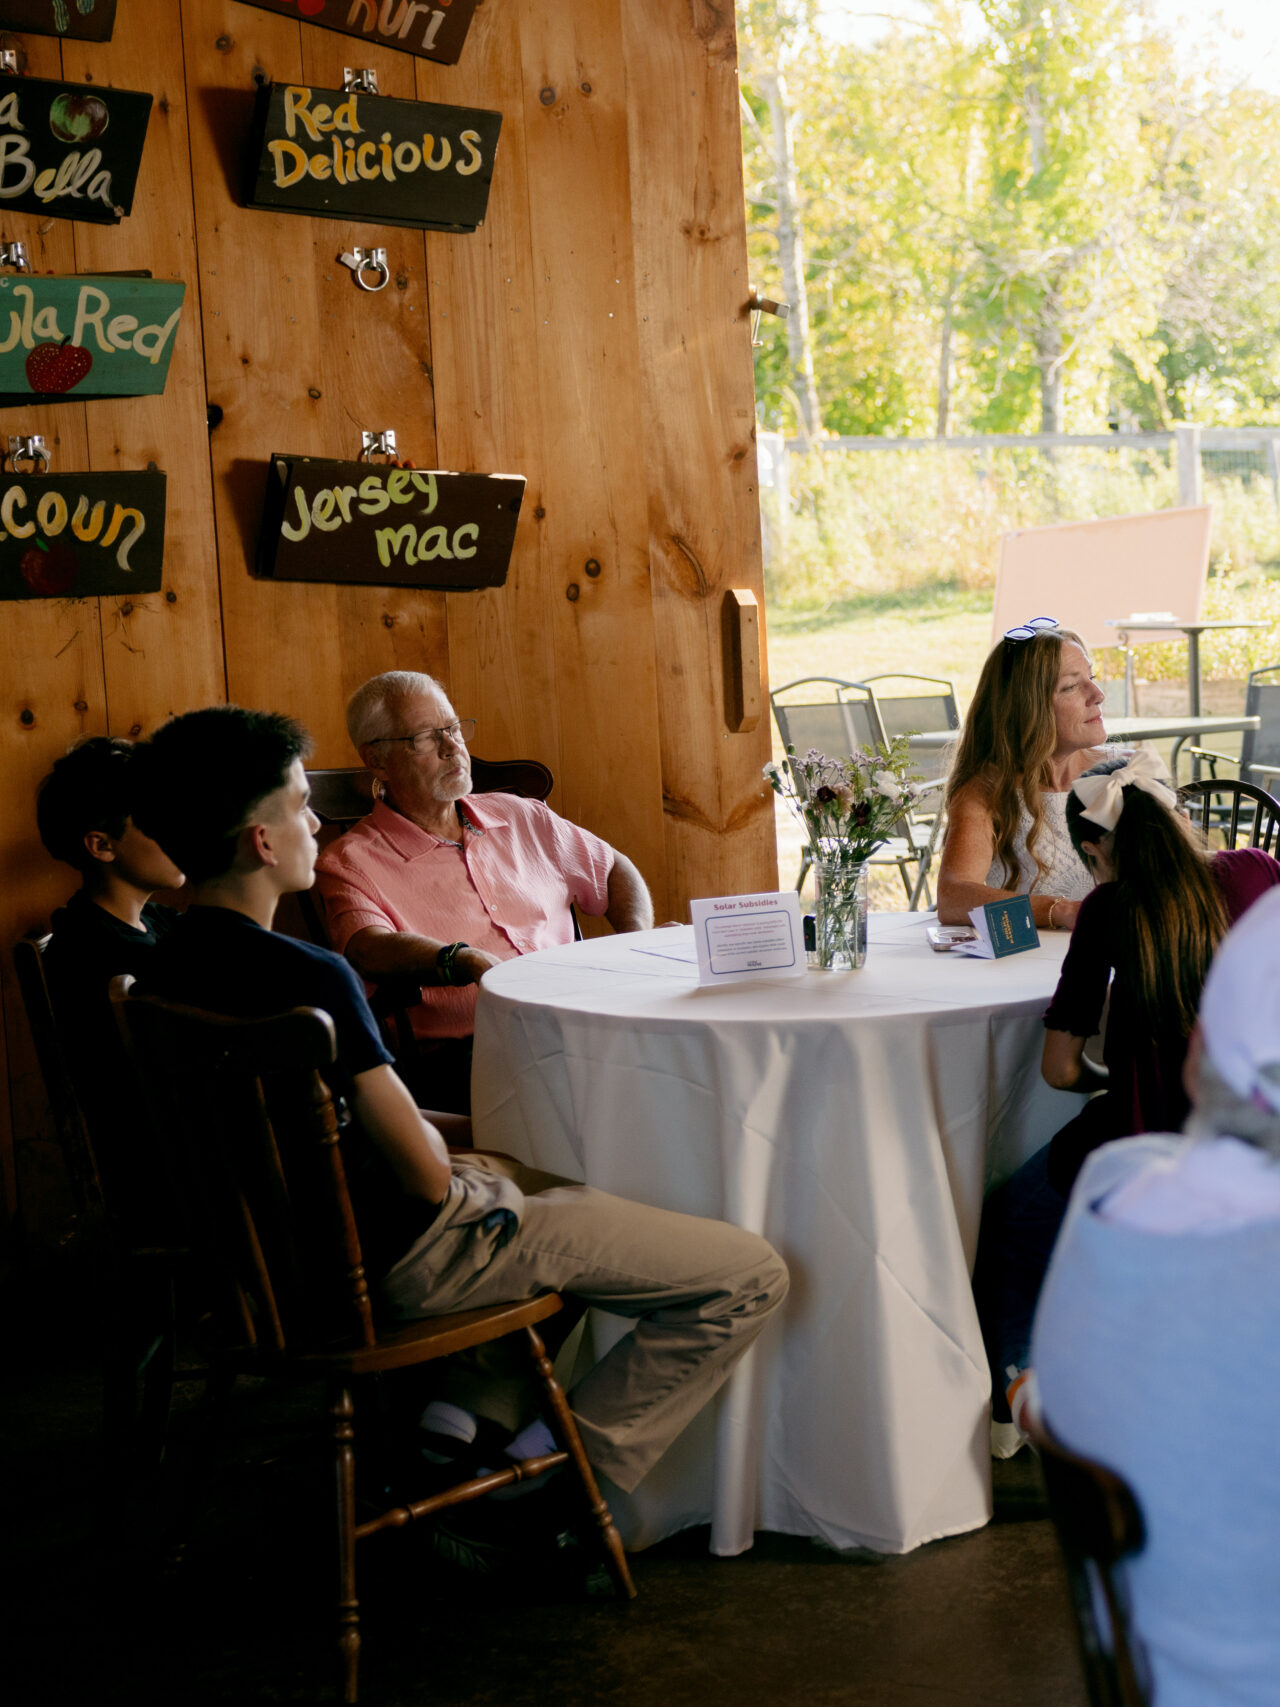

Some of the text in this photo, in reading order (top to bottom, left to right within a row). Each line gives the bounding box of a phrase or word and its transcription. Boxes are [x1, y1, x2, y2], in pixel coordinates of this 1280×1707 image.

[284, 86, 364, 141] Red
[0, 133, 115, 208] Bella
[267, 129, 482, 188] Delicious
[72, 285, 183, 365] Red
[0, 484, 146, 572] coun
[281, 469, 439, 542] Jersey
[713, 898, 778, 911] Solar Subsidies
